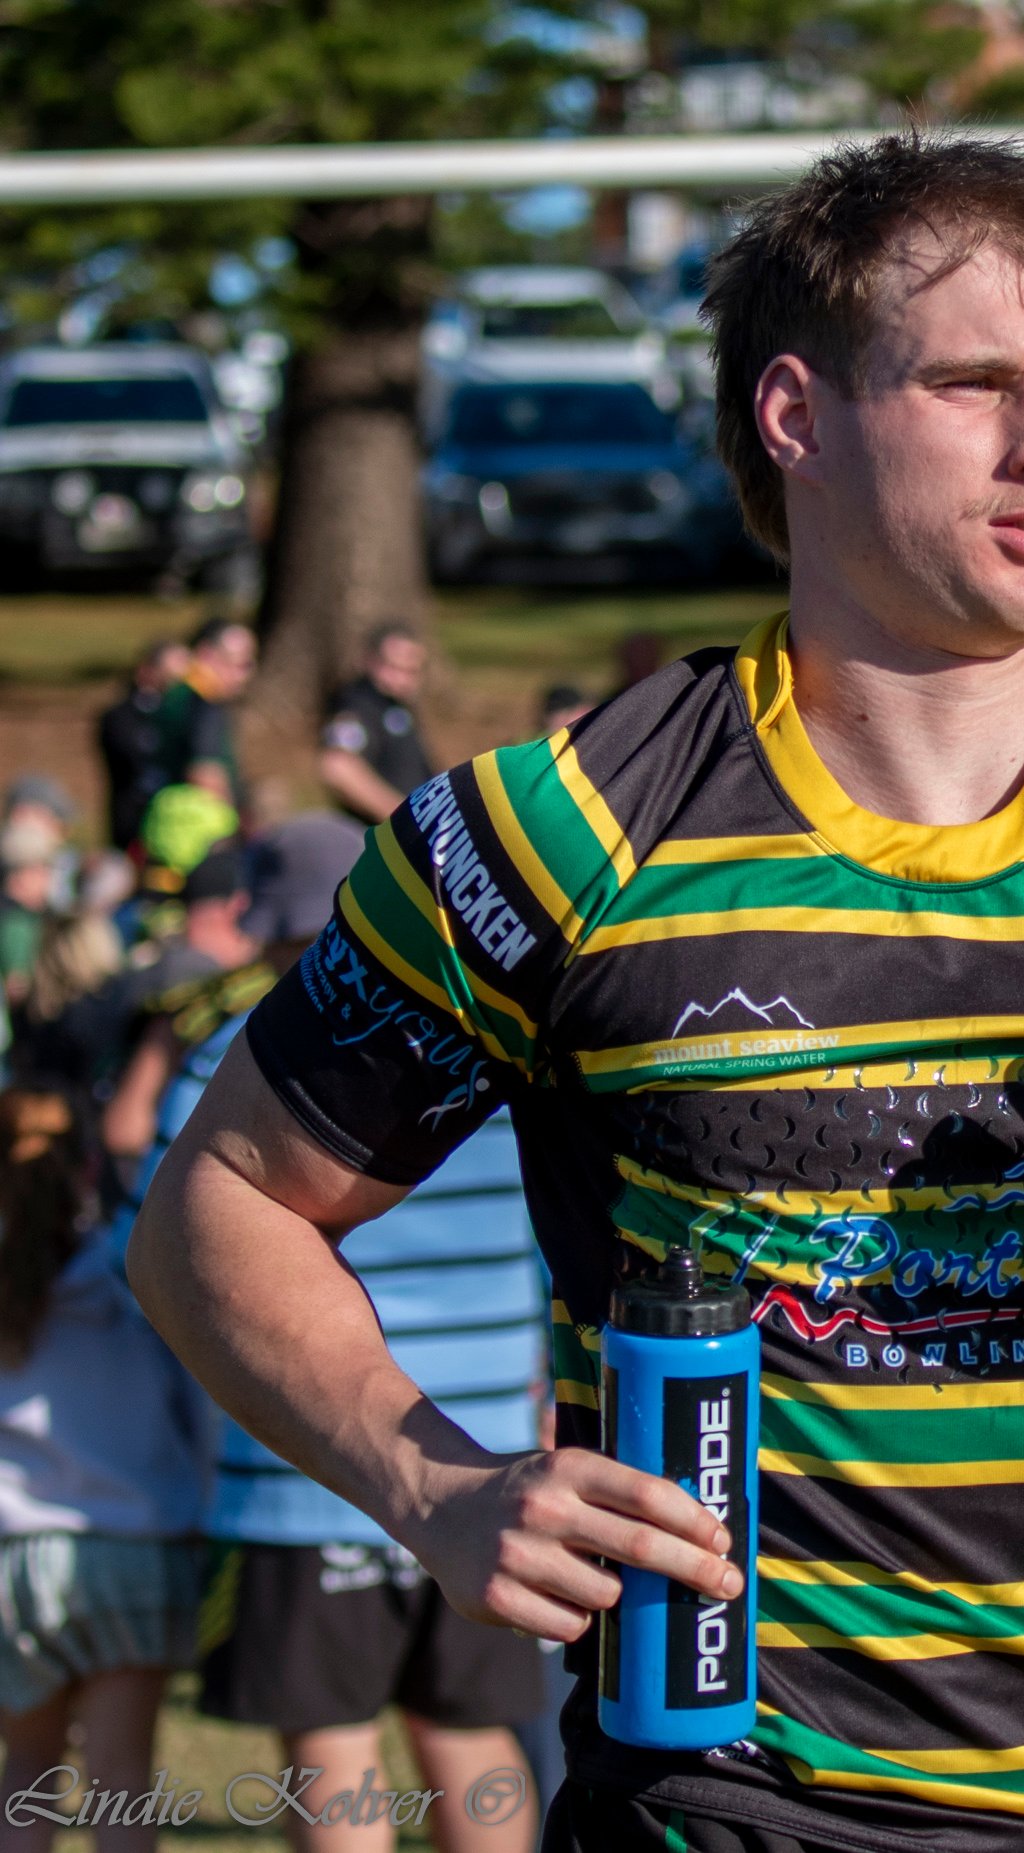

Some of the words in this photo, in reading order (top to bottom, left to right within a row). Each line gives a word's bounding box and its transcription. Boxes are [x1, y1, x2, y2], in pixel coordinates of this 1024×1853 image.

[653, 1038, 730, 1065] mount
[739, 1033, 840, 1056] seaview
[662, 1062, 721, 1077] NATURAL
[725, 1056, 776, 1069] SPRING
[778, 1052, 827, 1067] WATER
[808, 1215, 1022, 1303] Port
